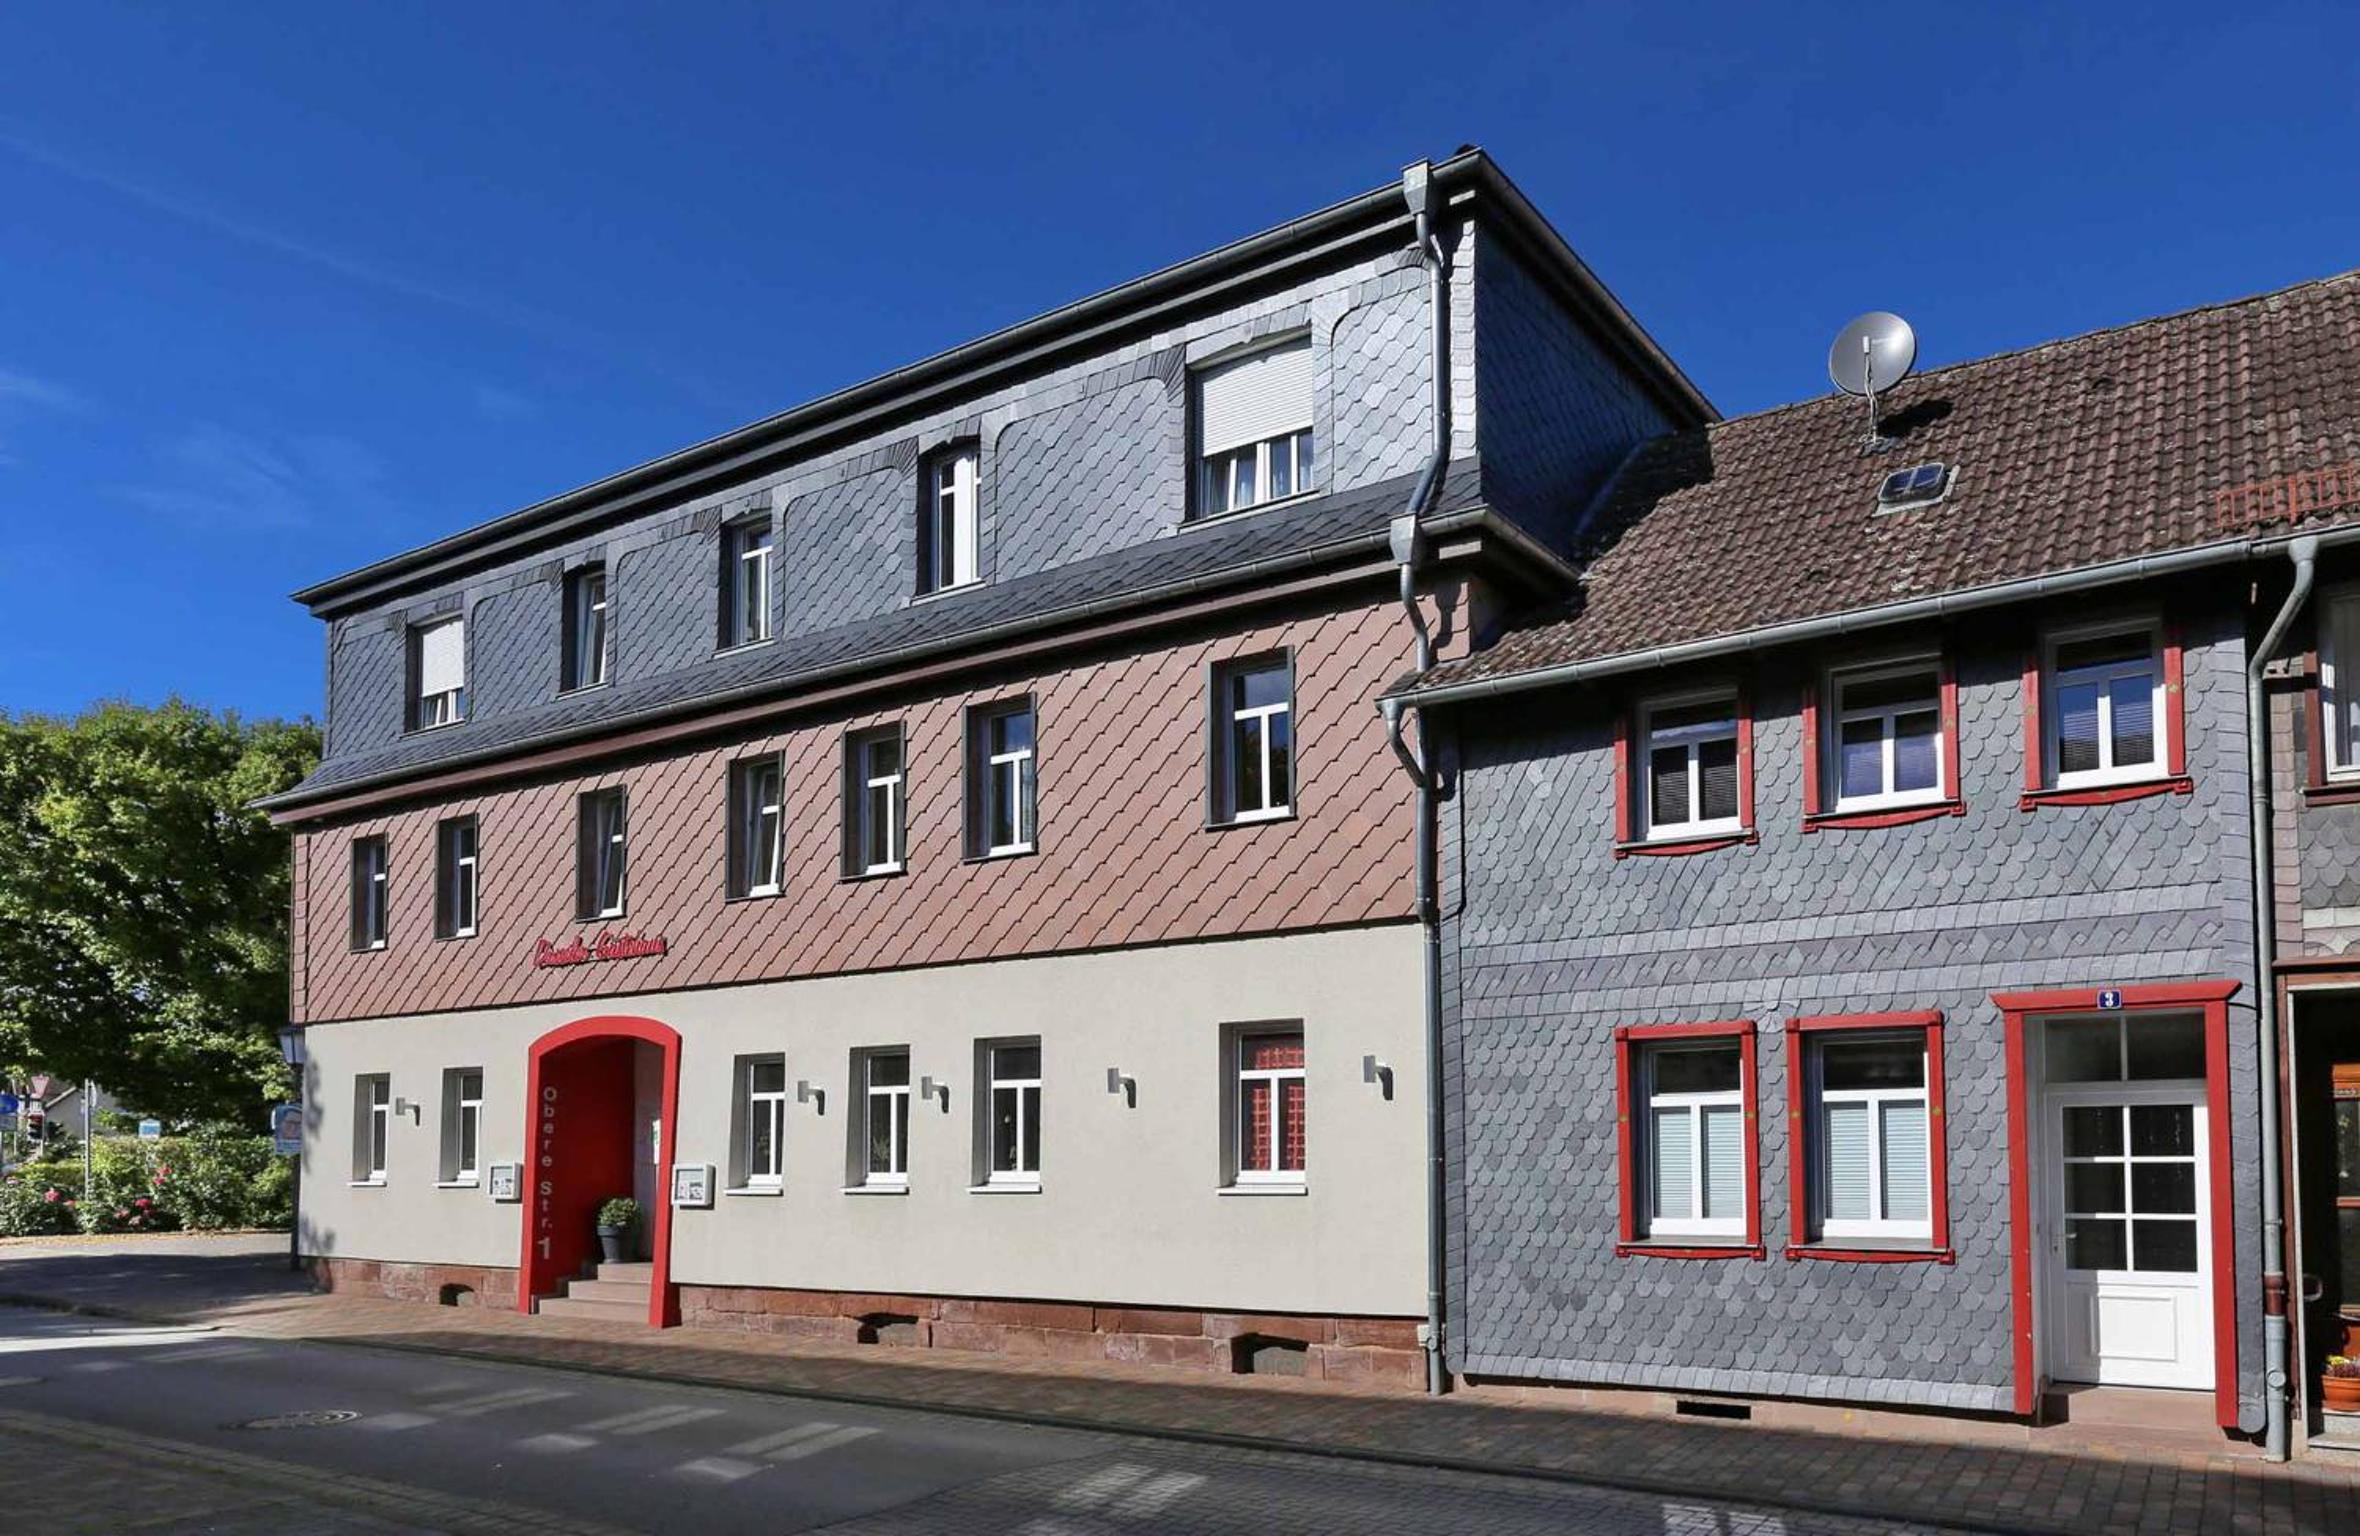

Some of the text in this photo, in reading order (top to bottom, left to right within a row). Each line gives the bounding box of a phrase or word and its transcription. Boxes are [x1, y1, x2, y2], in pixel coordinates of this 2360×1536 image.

[2104, 992, 2114, 1007] 3
[537, 1086, 557, 1261] Obere Str. 1
